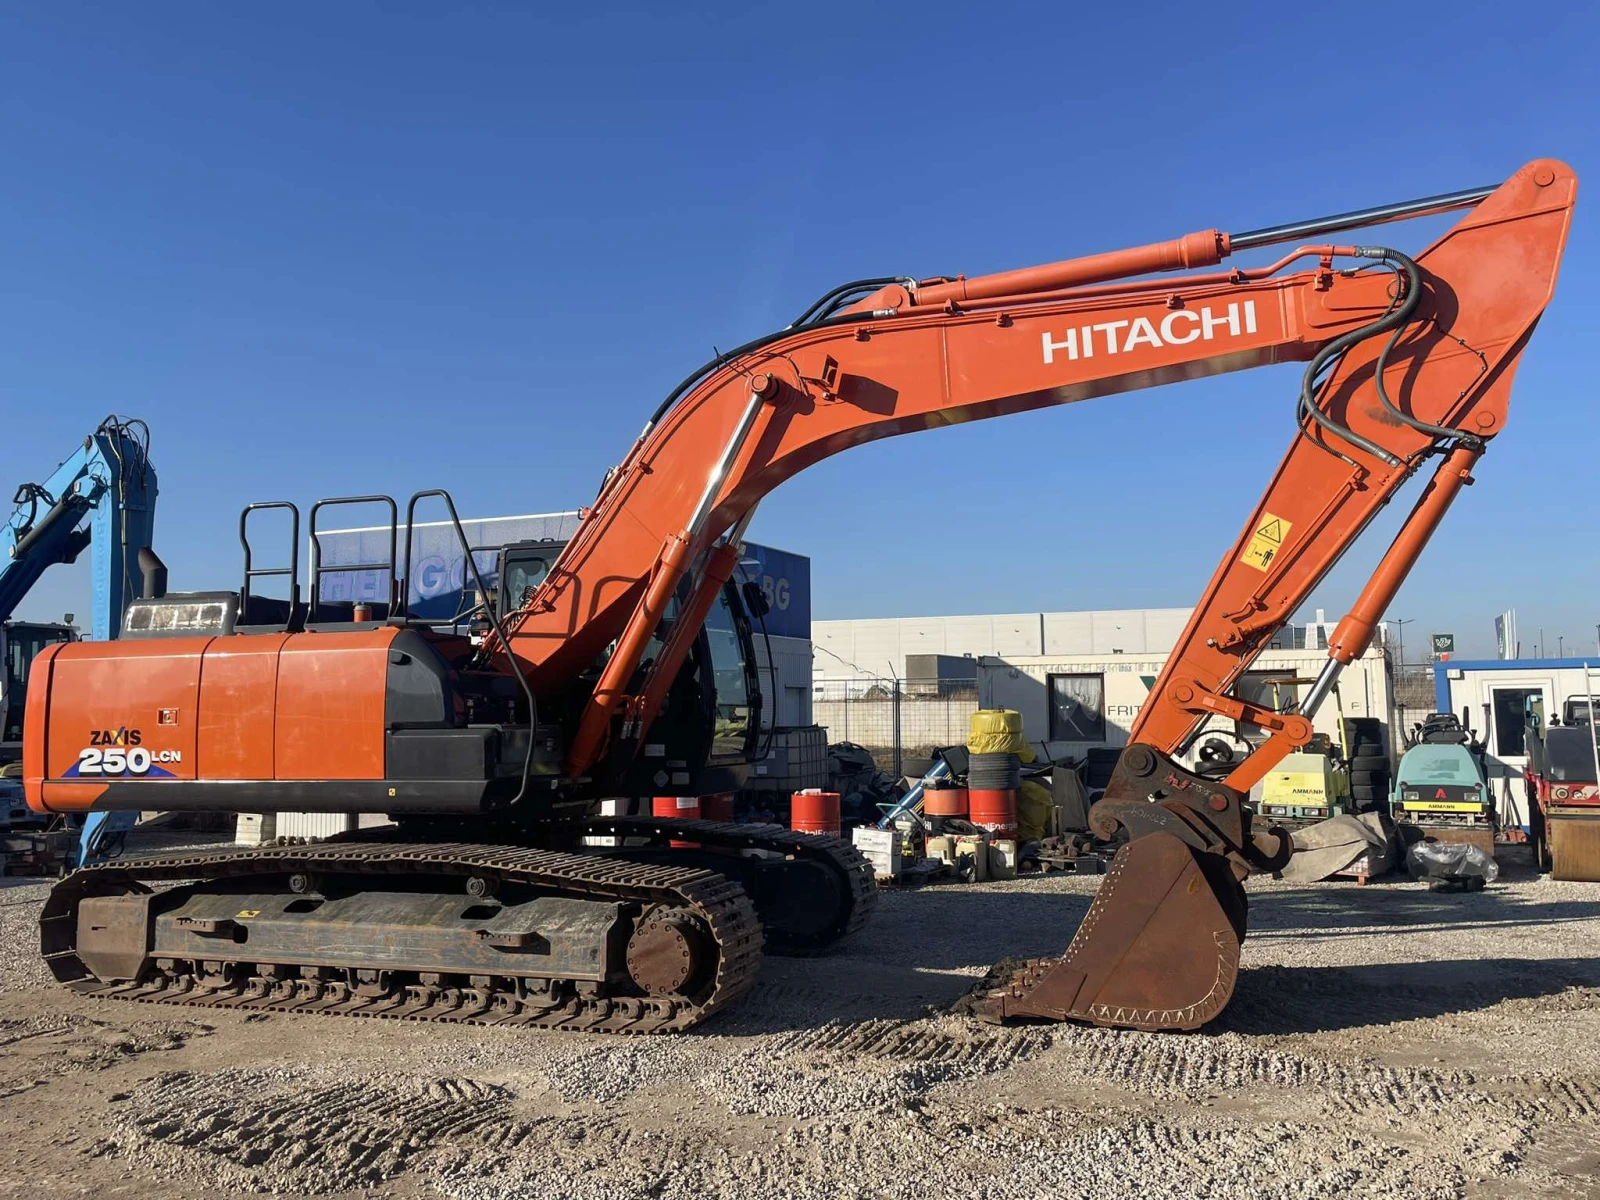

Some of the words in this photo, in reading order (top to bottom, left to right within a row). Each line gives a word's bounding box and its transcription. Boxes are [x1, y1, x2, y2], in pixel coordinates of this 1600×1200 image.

[1042, 300, 1257, 364] HITACHI
[1107, 705, 1143, 716] FRIT
[90, 726, 141, 746] ZAXIS
